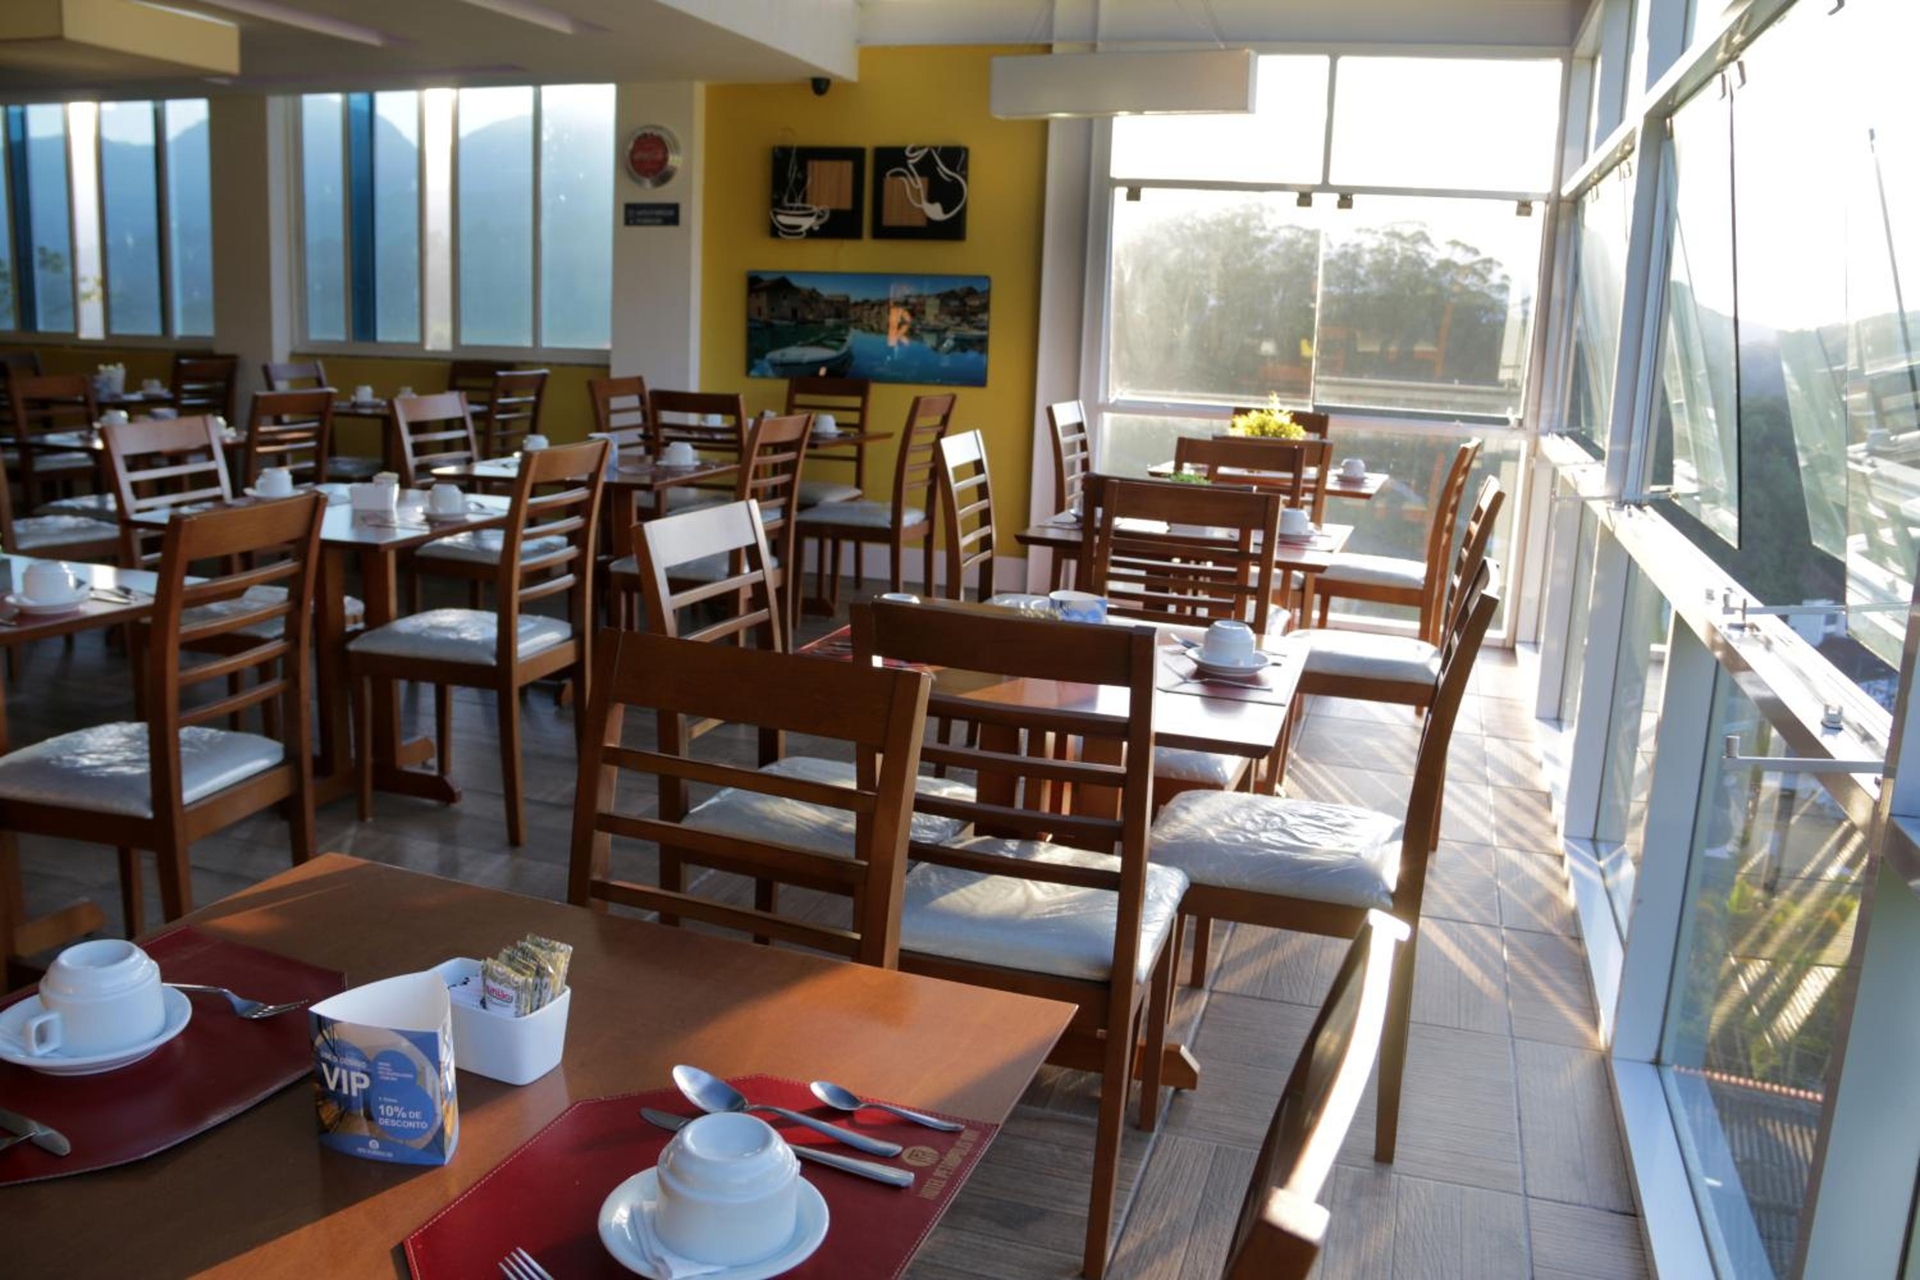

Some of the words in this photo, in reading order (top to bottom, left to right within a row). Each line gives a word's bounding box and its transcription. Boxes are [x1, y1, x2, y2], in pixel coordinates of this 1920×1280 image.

[321, 1062, 370, 1097] VIP
[378, 1104, 407, 1118] 10%
[408, 1110, 423, 1120] DE
[378, 1117, 429, 1129] DESCONTO
